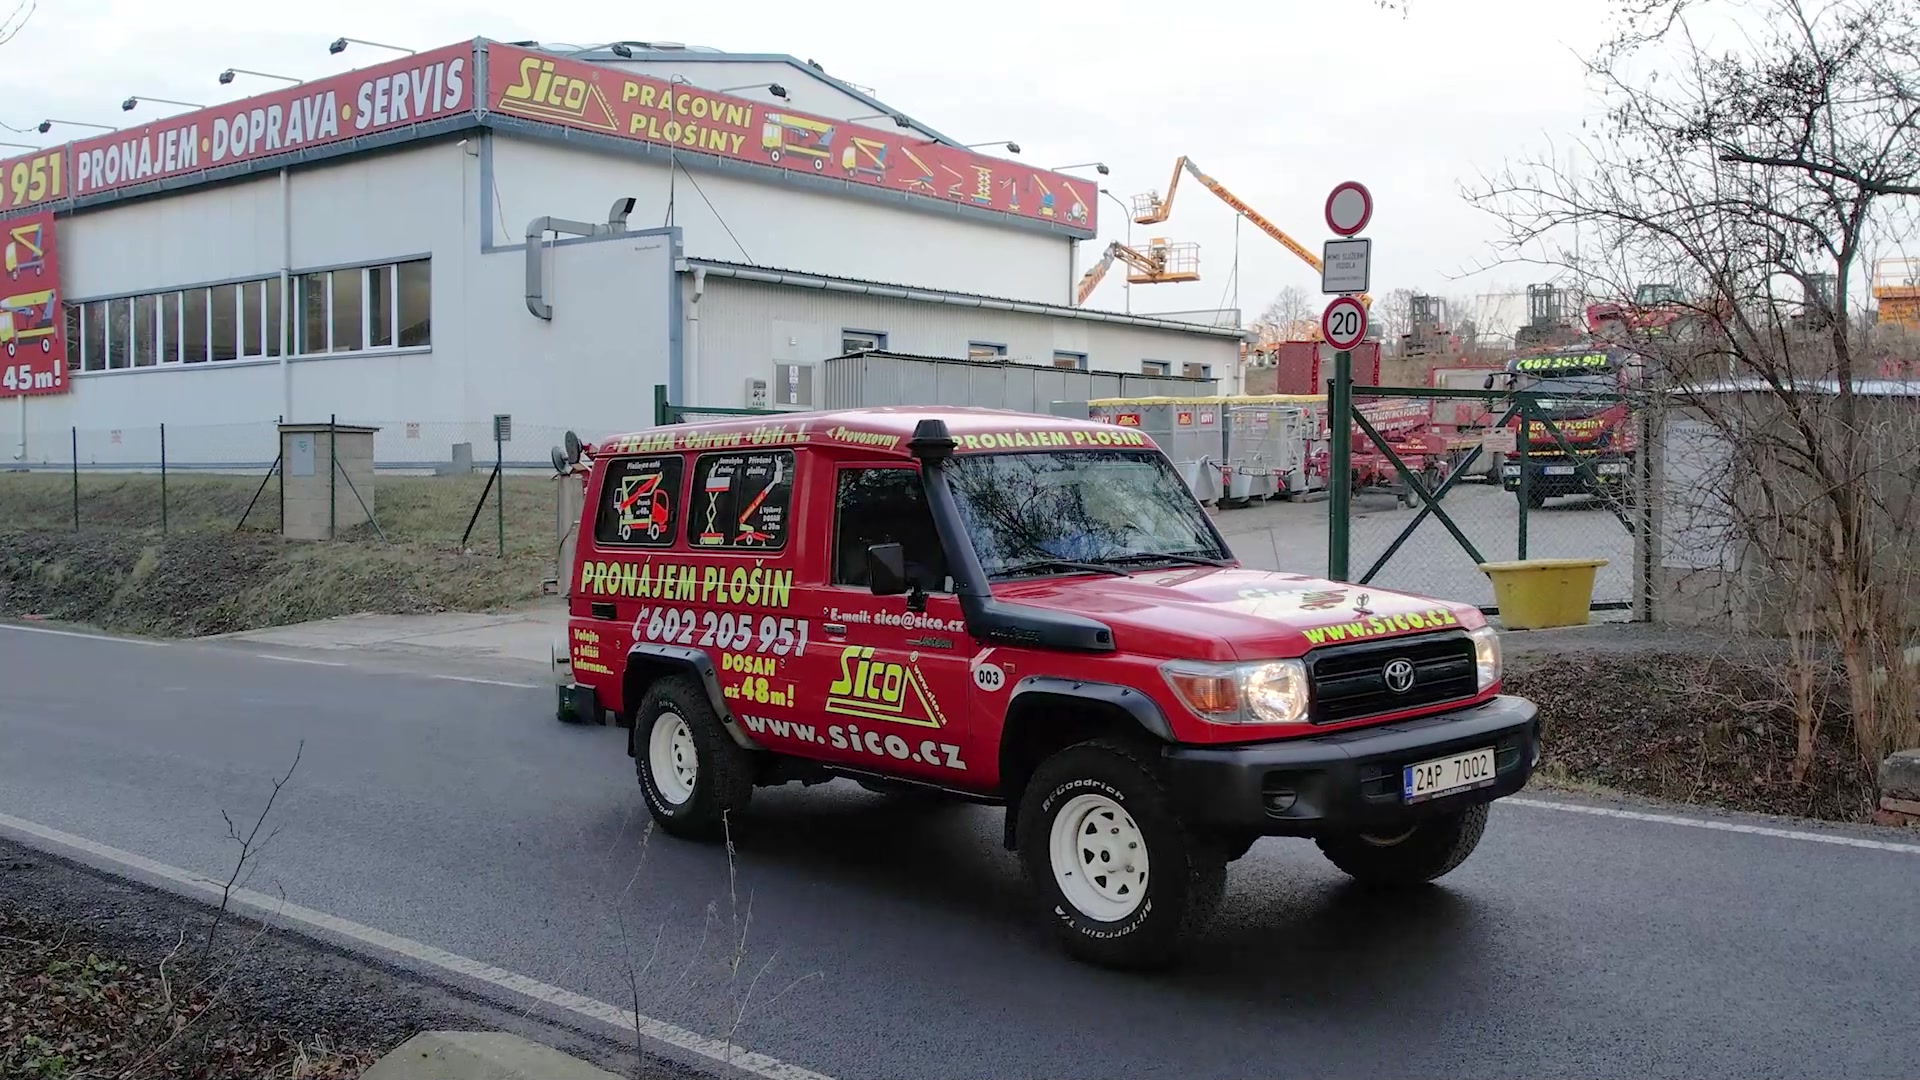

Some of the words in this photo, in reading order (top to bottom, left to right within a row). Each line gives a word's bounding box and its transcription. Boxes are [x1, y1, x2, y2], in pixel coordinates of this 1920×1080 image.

[504, 57, 586, 110] Sico
[622, 80, 753, 128] PRACOVNÍ
[77, 128, 199, 191] PRONÁJEM
[212, 90, 339, 162] DOPRAVA
[355, 57, 465, 131] SERVIS
[629, 114, 746, 155] PLOŠINY
[11, 151, 61, 206] 951
[1331, 311, 1358, 336] 20
[617, 431, 676, 452] PRAHA
[685, 430, 743, 449] Ostrava
[834, 426, 901, 451] Provozovny
[951, 428, 1070, 450] PRONÁJEM
[1071, 428, 1144, 446] PLOŠIN
[580, 554, 697, 602] PRONÁJEM
[701, 558, 793, 608] PLOŠIN
[646, 605, 697, 645] 602
[698, 610, 753, 651] 205
[756, 615, 809, 657] 951
[830, 607, 871, 625] E-mail:
[873, 607, 966, 633] sico@sico.cz
[1302, 608, 1457, 645] www.sico.cz
[722, 652, 776, 677] DOSAH
[829, 645, 903, 703] Sico
[978, 671, 1000, 686] 003
[723, 682, 740, 700] až
[914, 663, 948, 726] www.sico.cz
[741, 713, 968, 770] www.sico.cz
[1415, 764, 1443, 792] 2AP
[1453, 754, 1489, 783] 7002
[1042, 778, 1126, 813] BFGoodrich
